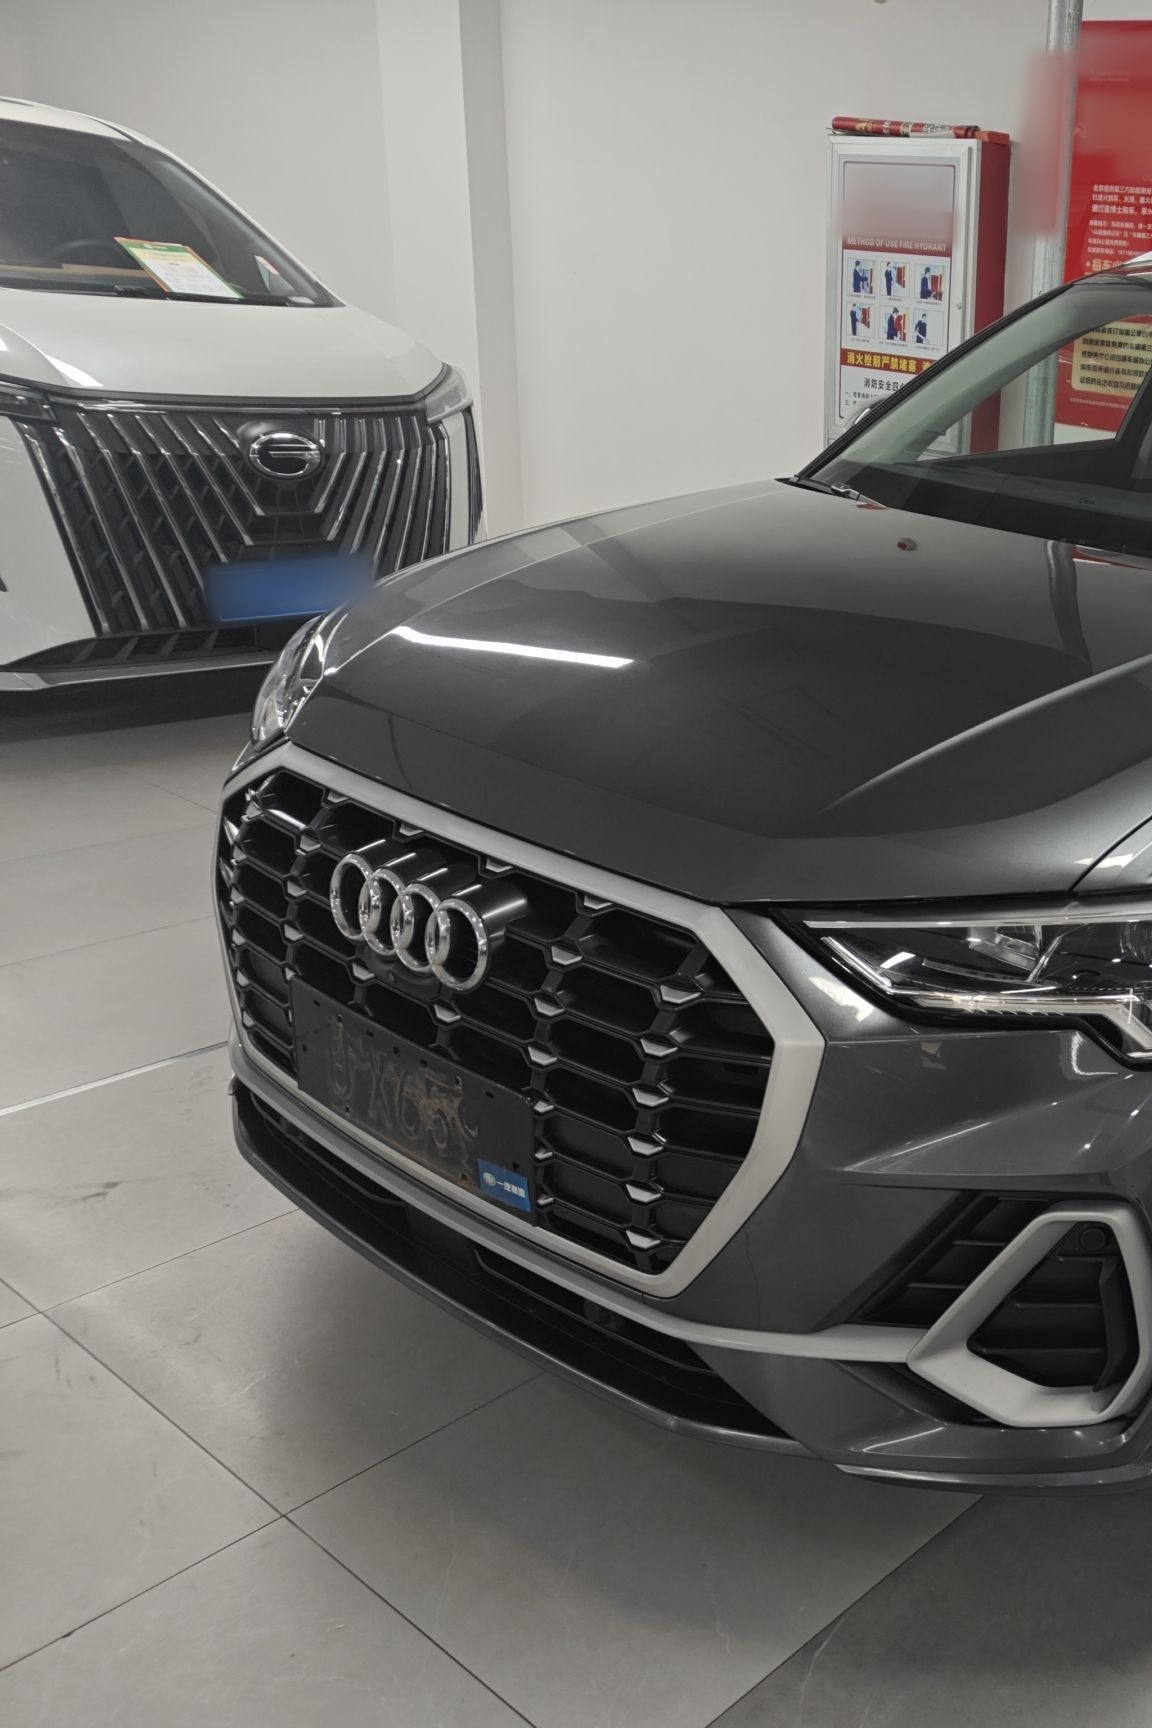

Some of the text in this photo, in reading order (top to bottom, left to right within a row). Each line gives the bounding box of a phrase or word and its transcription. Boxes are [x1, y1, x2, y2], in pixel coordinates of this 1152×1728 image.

[847, 237, 947, 252] METHOD OF USE FIRE HYDRANT
[847, 352, 917, 372] 消火栓前严禁堵塞
